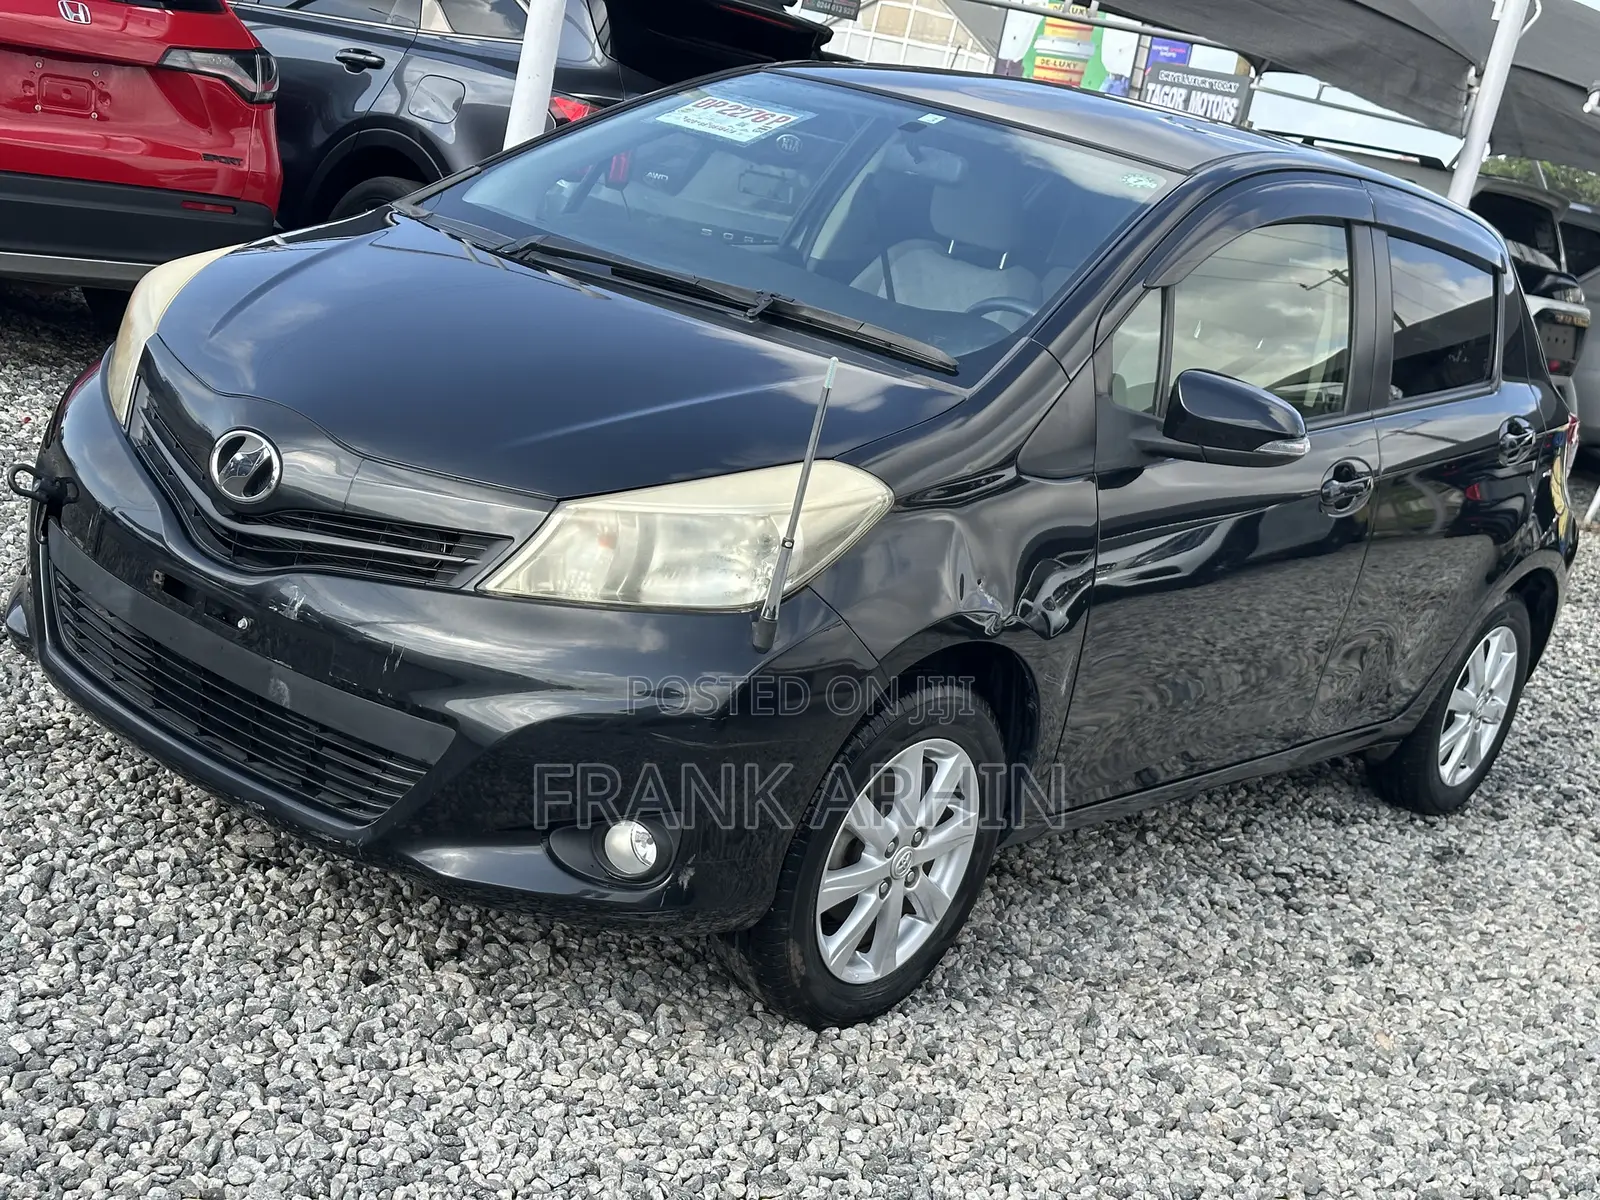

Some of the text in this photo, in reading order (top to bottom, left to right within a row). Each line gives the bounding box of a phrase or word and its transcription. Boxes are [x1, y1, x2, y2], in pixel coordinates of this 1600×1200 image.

[1146, 82, 1240, 122] TAGOR MOTORS
[202, 153, 243, 166] SPORT
[645, 171, 669, 181] AWD
